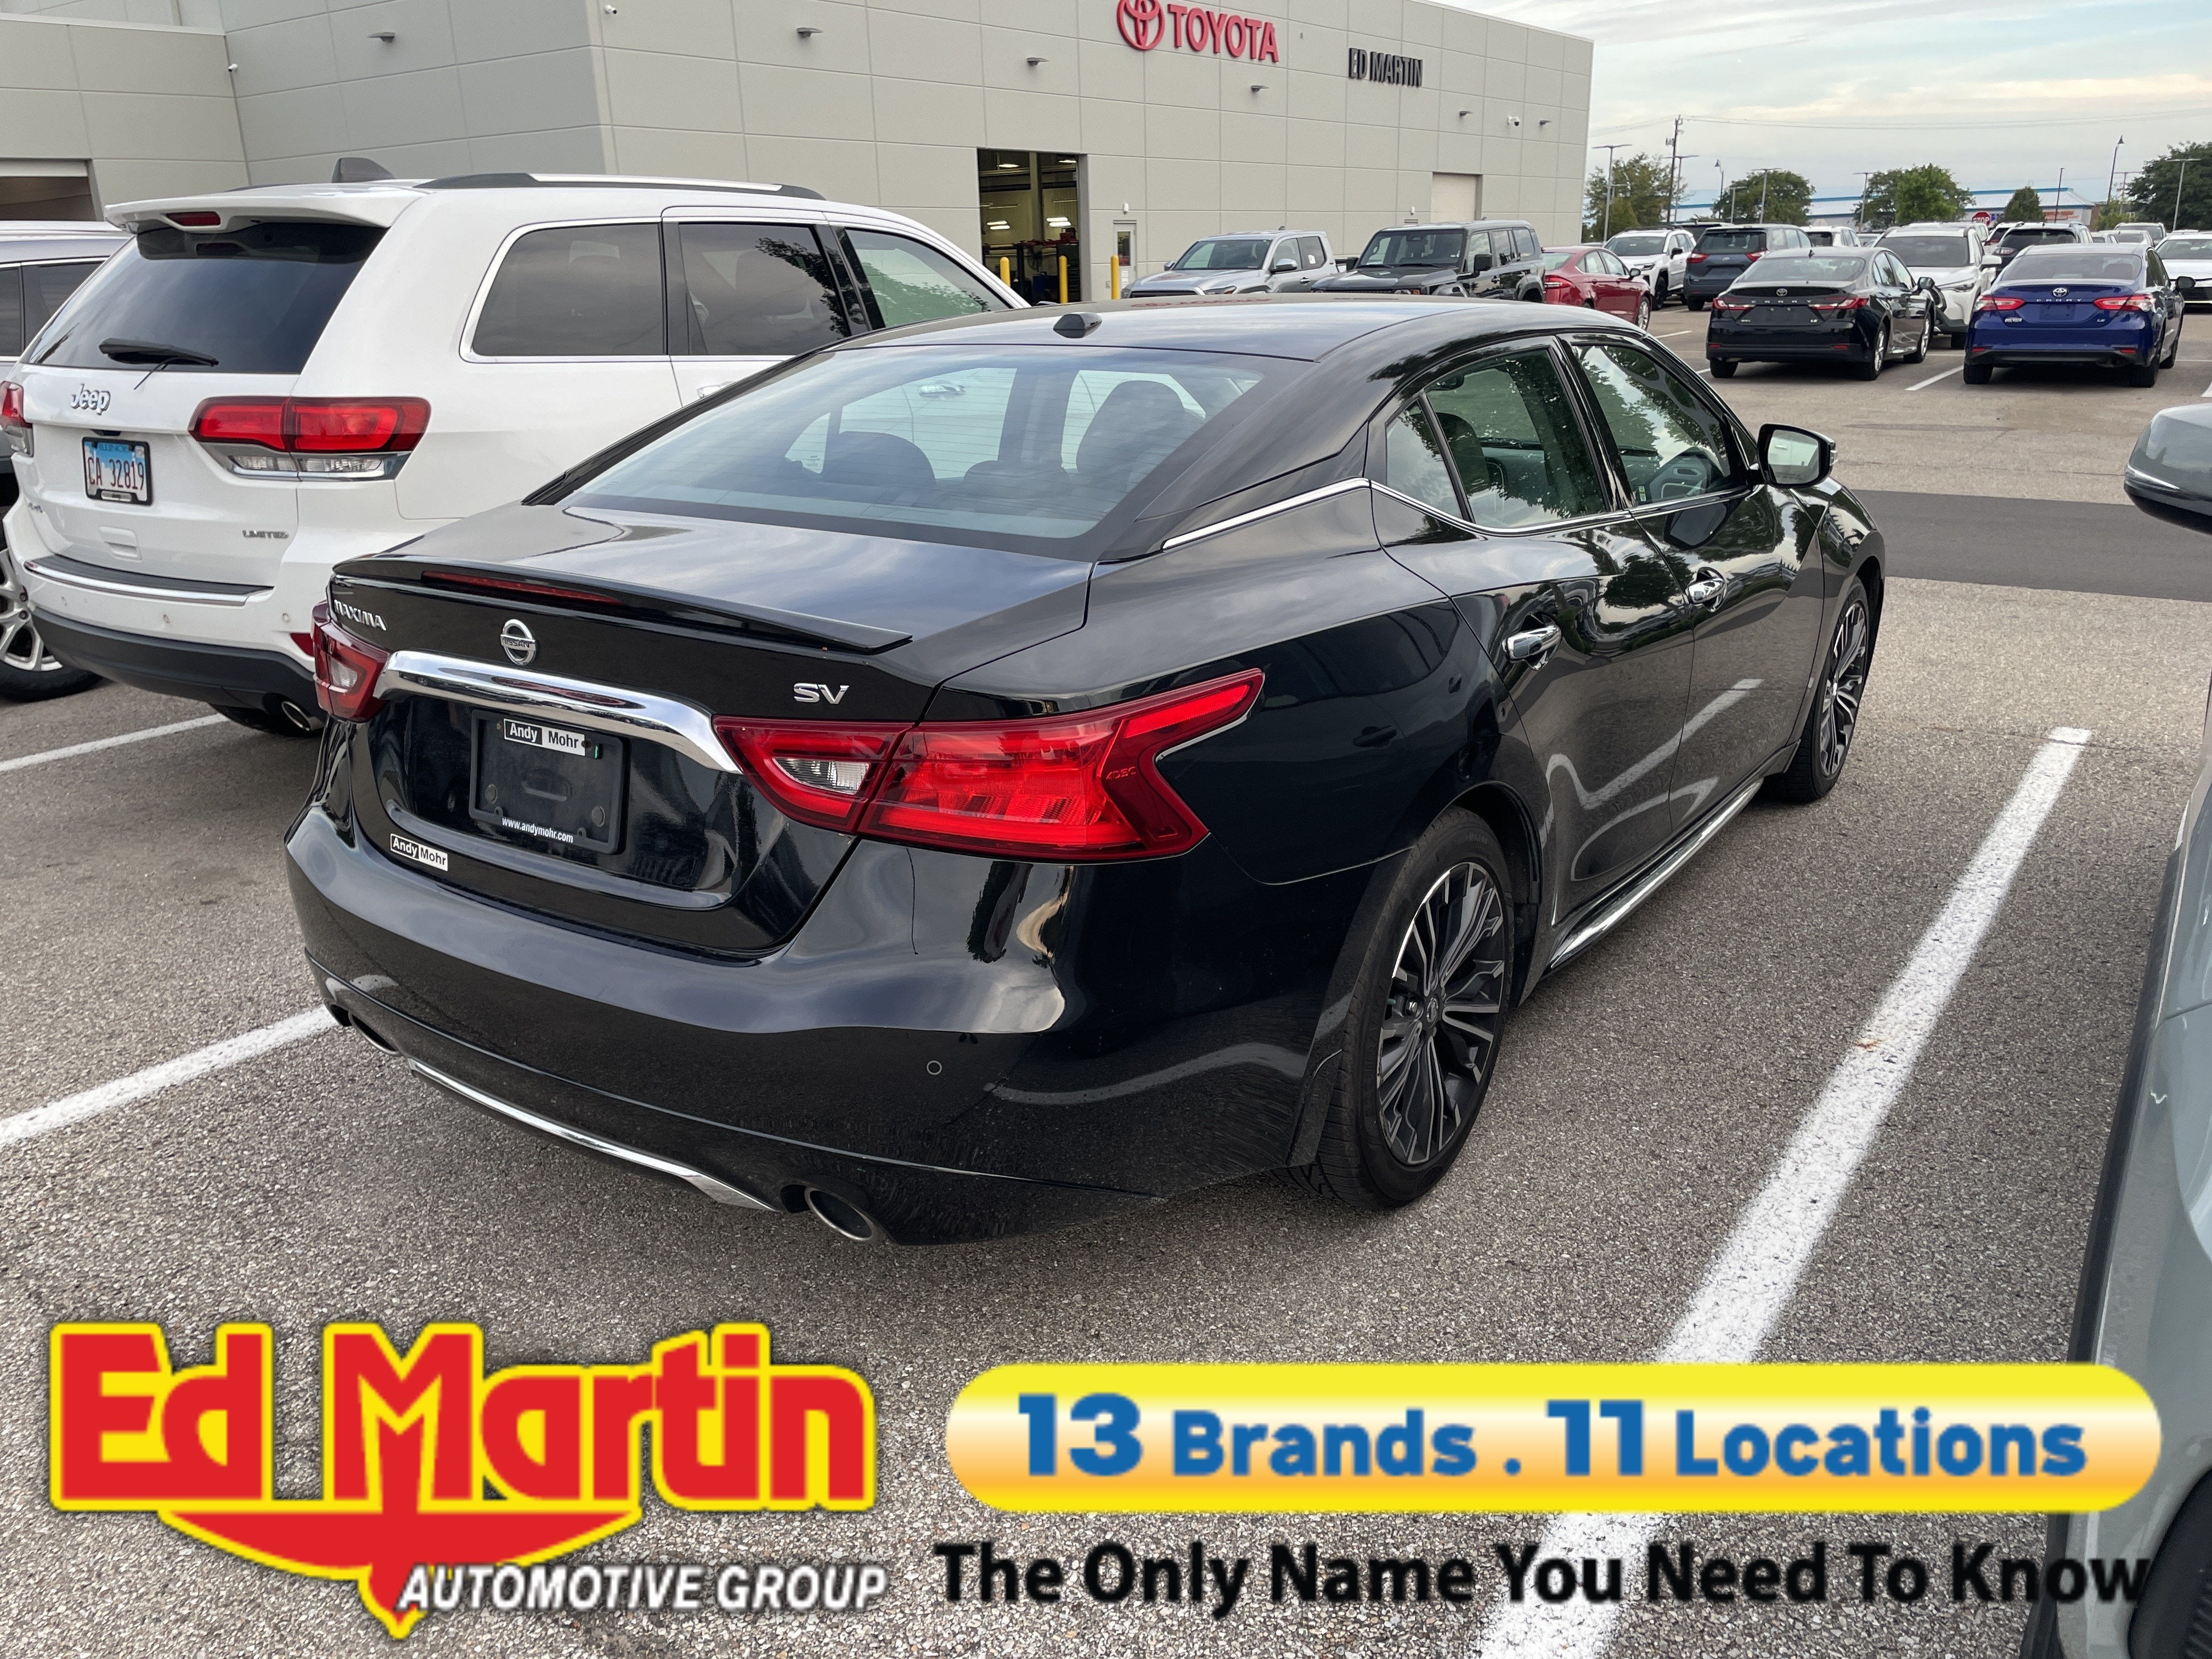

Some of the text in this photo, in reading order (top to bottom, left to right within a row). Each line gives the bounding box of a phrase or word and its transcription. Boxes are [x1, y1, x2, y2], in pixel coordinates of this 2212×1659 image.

[1167, 4, 1279, 63] TOYOTA
[1348, 47, 1423, 88] ED MARTIN
[70, 383, 111, 416] Jeep
[88, 457, 144, 490] CA 32819
[242, 529, 289, 539] LIMITED
[334, 599, 387, 631] MAXIMA
[503, 636, 530, 648] NISSAN
[793, 682, 850, 704] SV
[510, 723, 579, 748] Andy Mohr
[501, 816, 574, 844] www.andymohr.com
[393, 837, 446, 866] Andy Mohr
